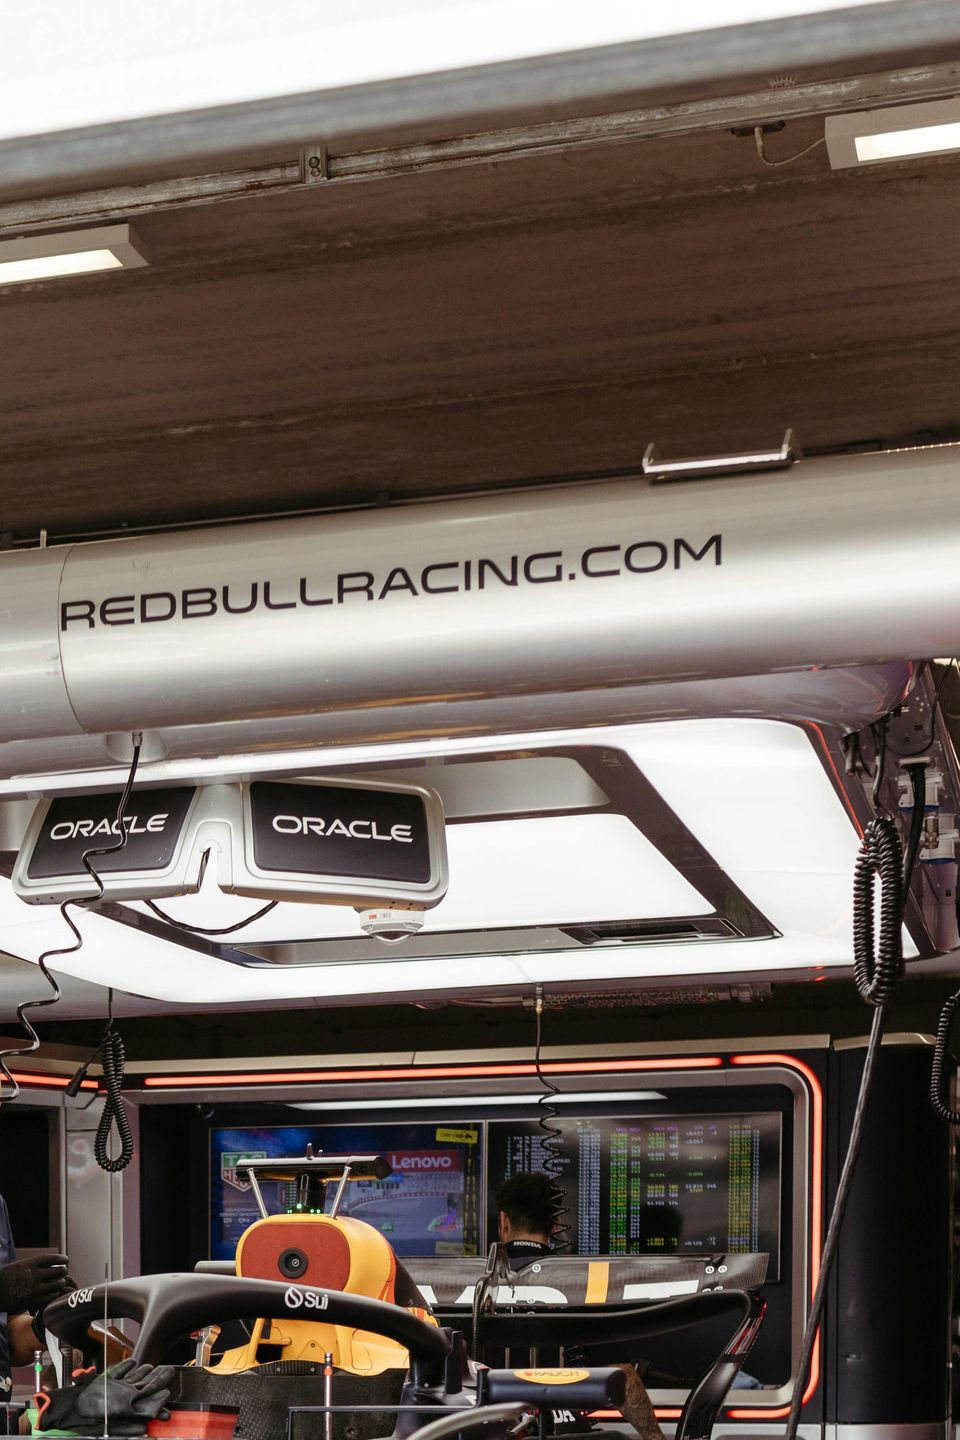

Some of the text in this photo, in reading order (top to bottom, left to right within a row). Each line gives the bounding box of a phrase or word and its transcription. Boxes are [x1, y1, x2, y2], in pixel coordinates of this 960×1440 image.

[60, 534, 723, 631] REDBULLRACING.COM
[50, 813, 169, 840] ORACLE
[272, 814, 413, 843] ORACLE
[392, 1154, 452, 1169] Lenovo
[513, 1241, 542, 1249] HONDA
[304, 1291, 328, 1310] Sui
